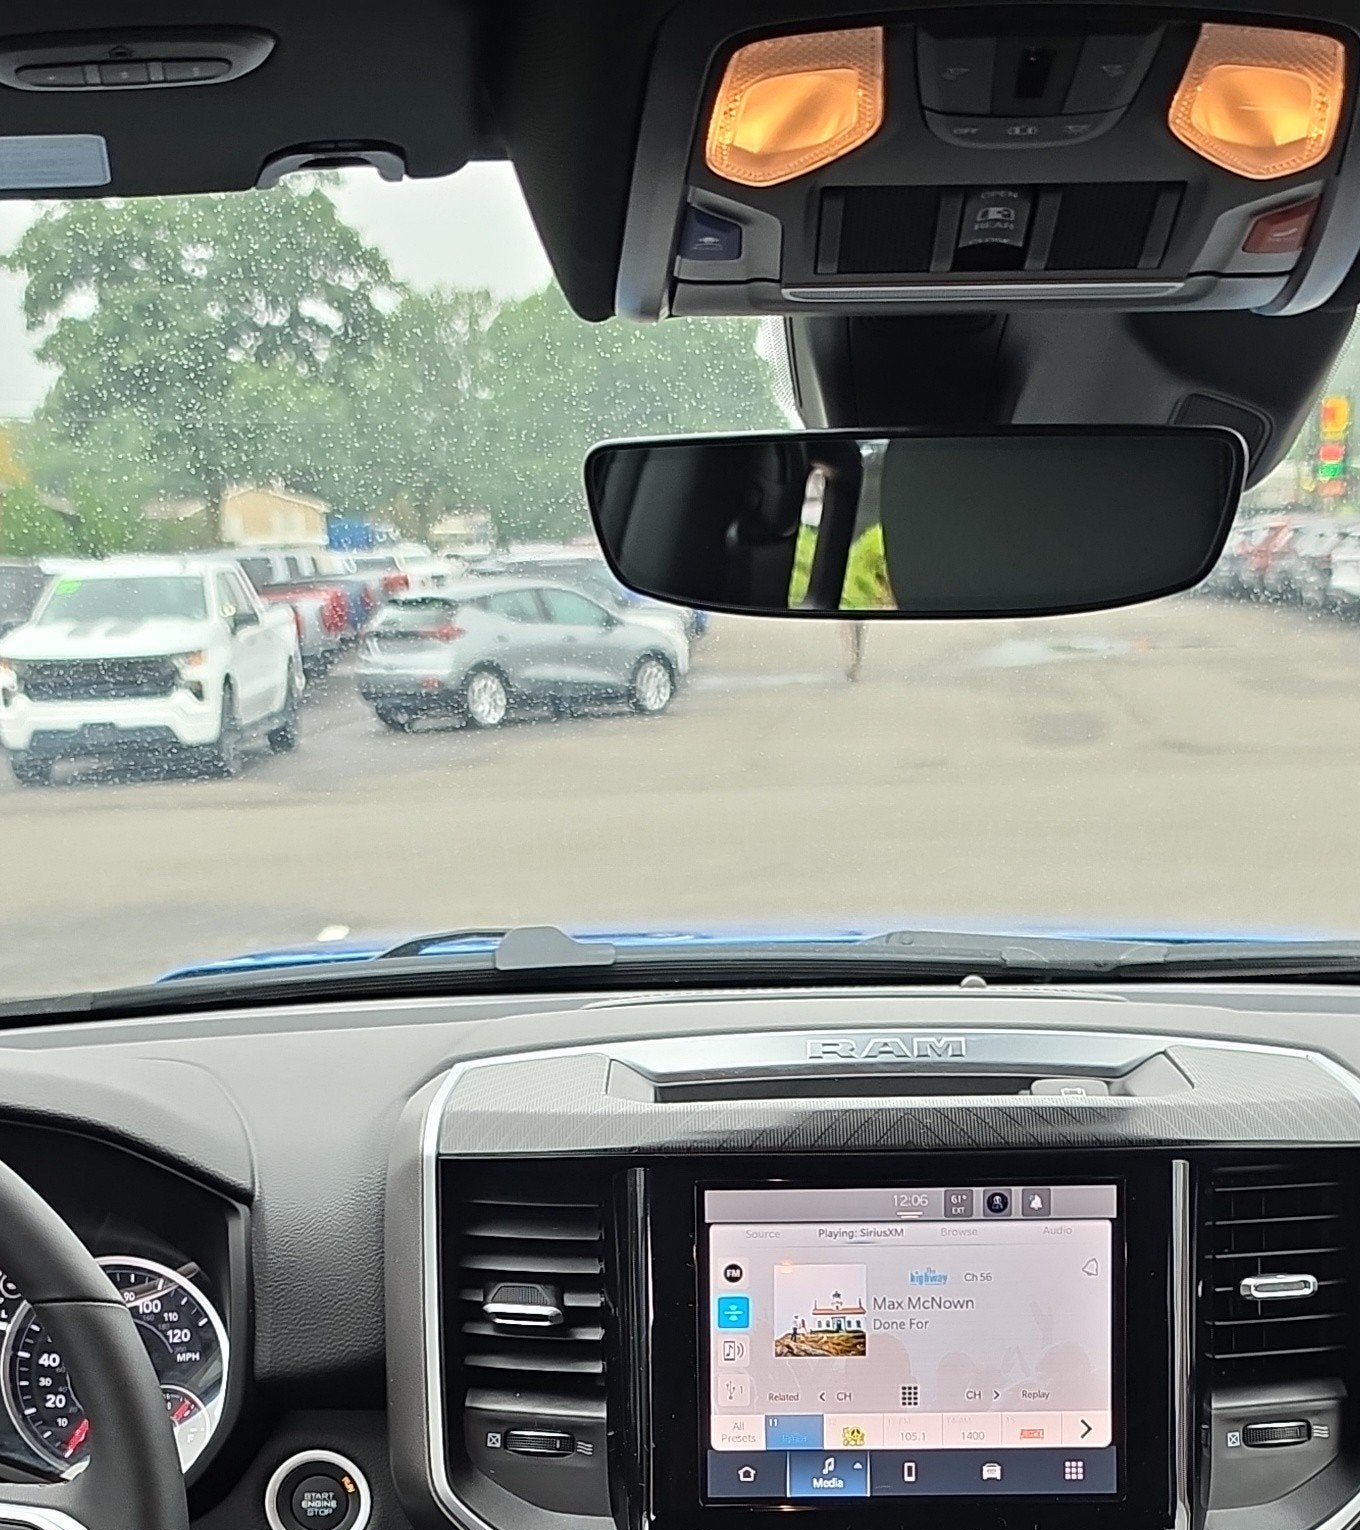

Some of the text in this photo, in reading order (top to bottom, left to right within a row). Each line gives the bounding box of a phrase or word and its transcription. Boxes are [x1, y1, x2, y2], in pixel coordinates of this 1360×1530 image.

[805, 1036, 967, 1060] RAM
[892, 1194, 929, 1207] 12:06
[952, 1206, 966, 1215] EXT
[745, 1229, 781, 1239] Source
[818, 1227, 905, 1240] Playing: SiriusXM
[941, 1227, 978, 1237] Browse
[1042, 1226, 1073, 1236] Audio
[726, 1269, 741, 1278] FM
[964, 1273, 992, 1282] Ch 56
[138, 1299, 162, 1314] 100
[873, 1296, 975, 1310] Max McNown
[163, 1312, 179, 1322] 110
[873, 1318, 930, 1330] Done For
[166, 1329, 191, 1344] 120
[38, 1353, 61, 1368] 40
[176, 1352, 200, 1363] MPH
[38, 1376, 52, 1387] 30
[768, 1389, 1051, 1402] Related CH CH Replay
[45, 1394, 66, 1409] 20
[56, 1417, 69, 1428] 10
[732, 1422, 746, 1431] All
[768, 1418, 778, 1427] 11
[721, 1434, 757, 1443] Presets
[900, 1432, 926, 1441] 105.1
[961, 1431, 985, 1441] 1400
[812, 1477, 844, 1489] Media
[304, 1492, 335, 1500] START
[301, 1500, 337, 1509] ENGINE
[306, 1508, 333, 1517] STOP
